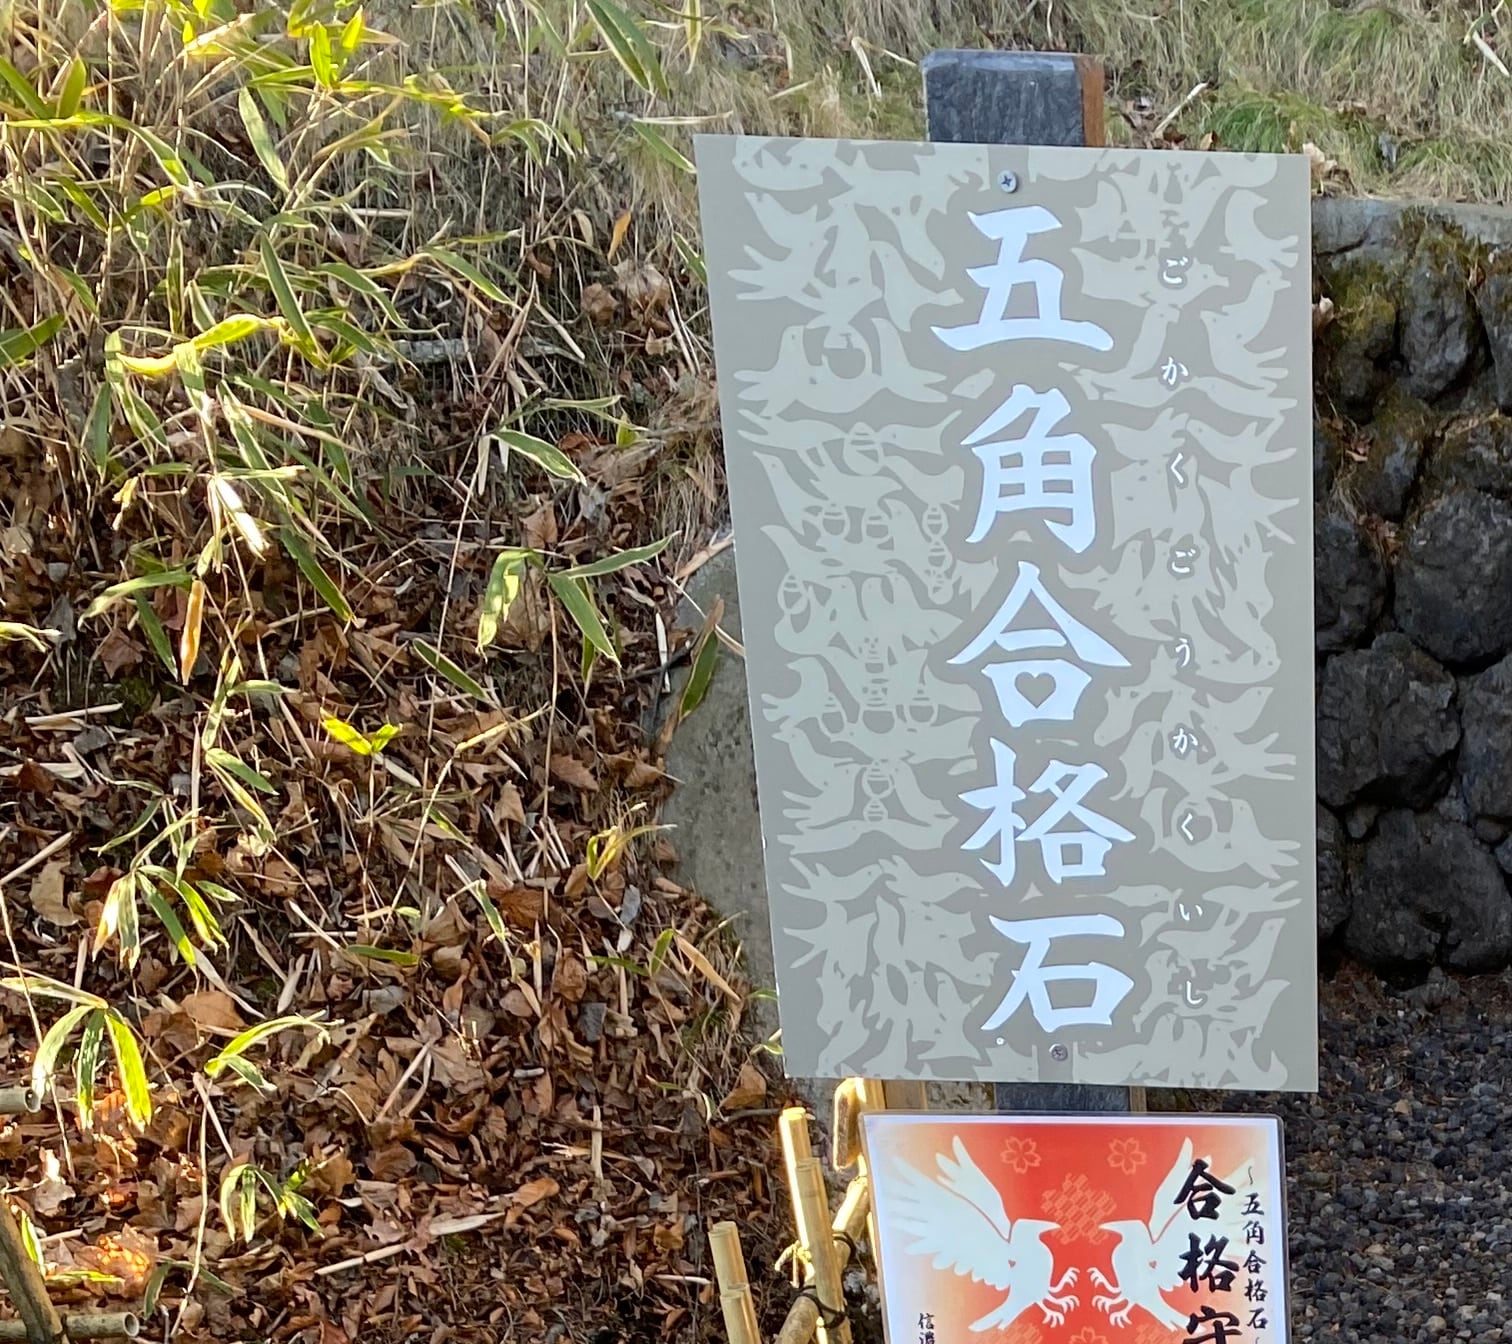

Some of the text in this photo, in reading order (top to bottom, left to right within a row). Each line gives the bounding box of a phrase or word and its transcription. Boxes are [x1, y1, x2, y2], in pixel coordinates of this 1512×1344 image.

[930, 205, 1137, 1034] 五角合格石
[1158, 254, 1206, 1008] ごかくごうかくいし
